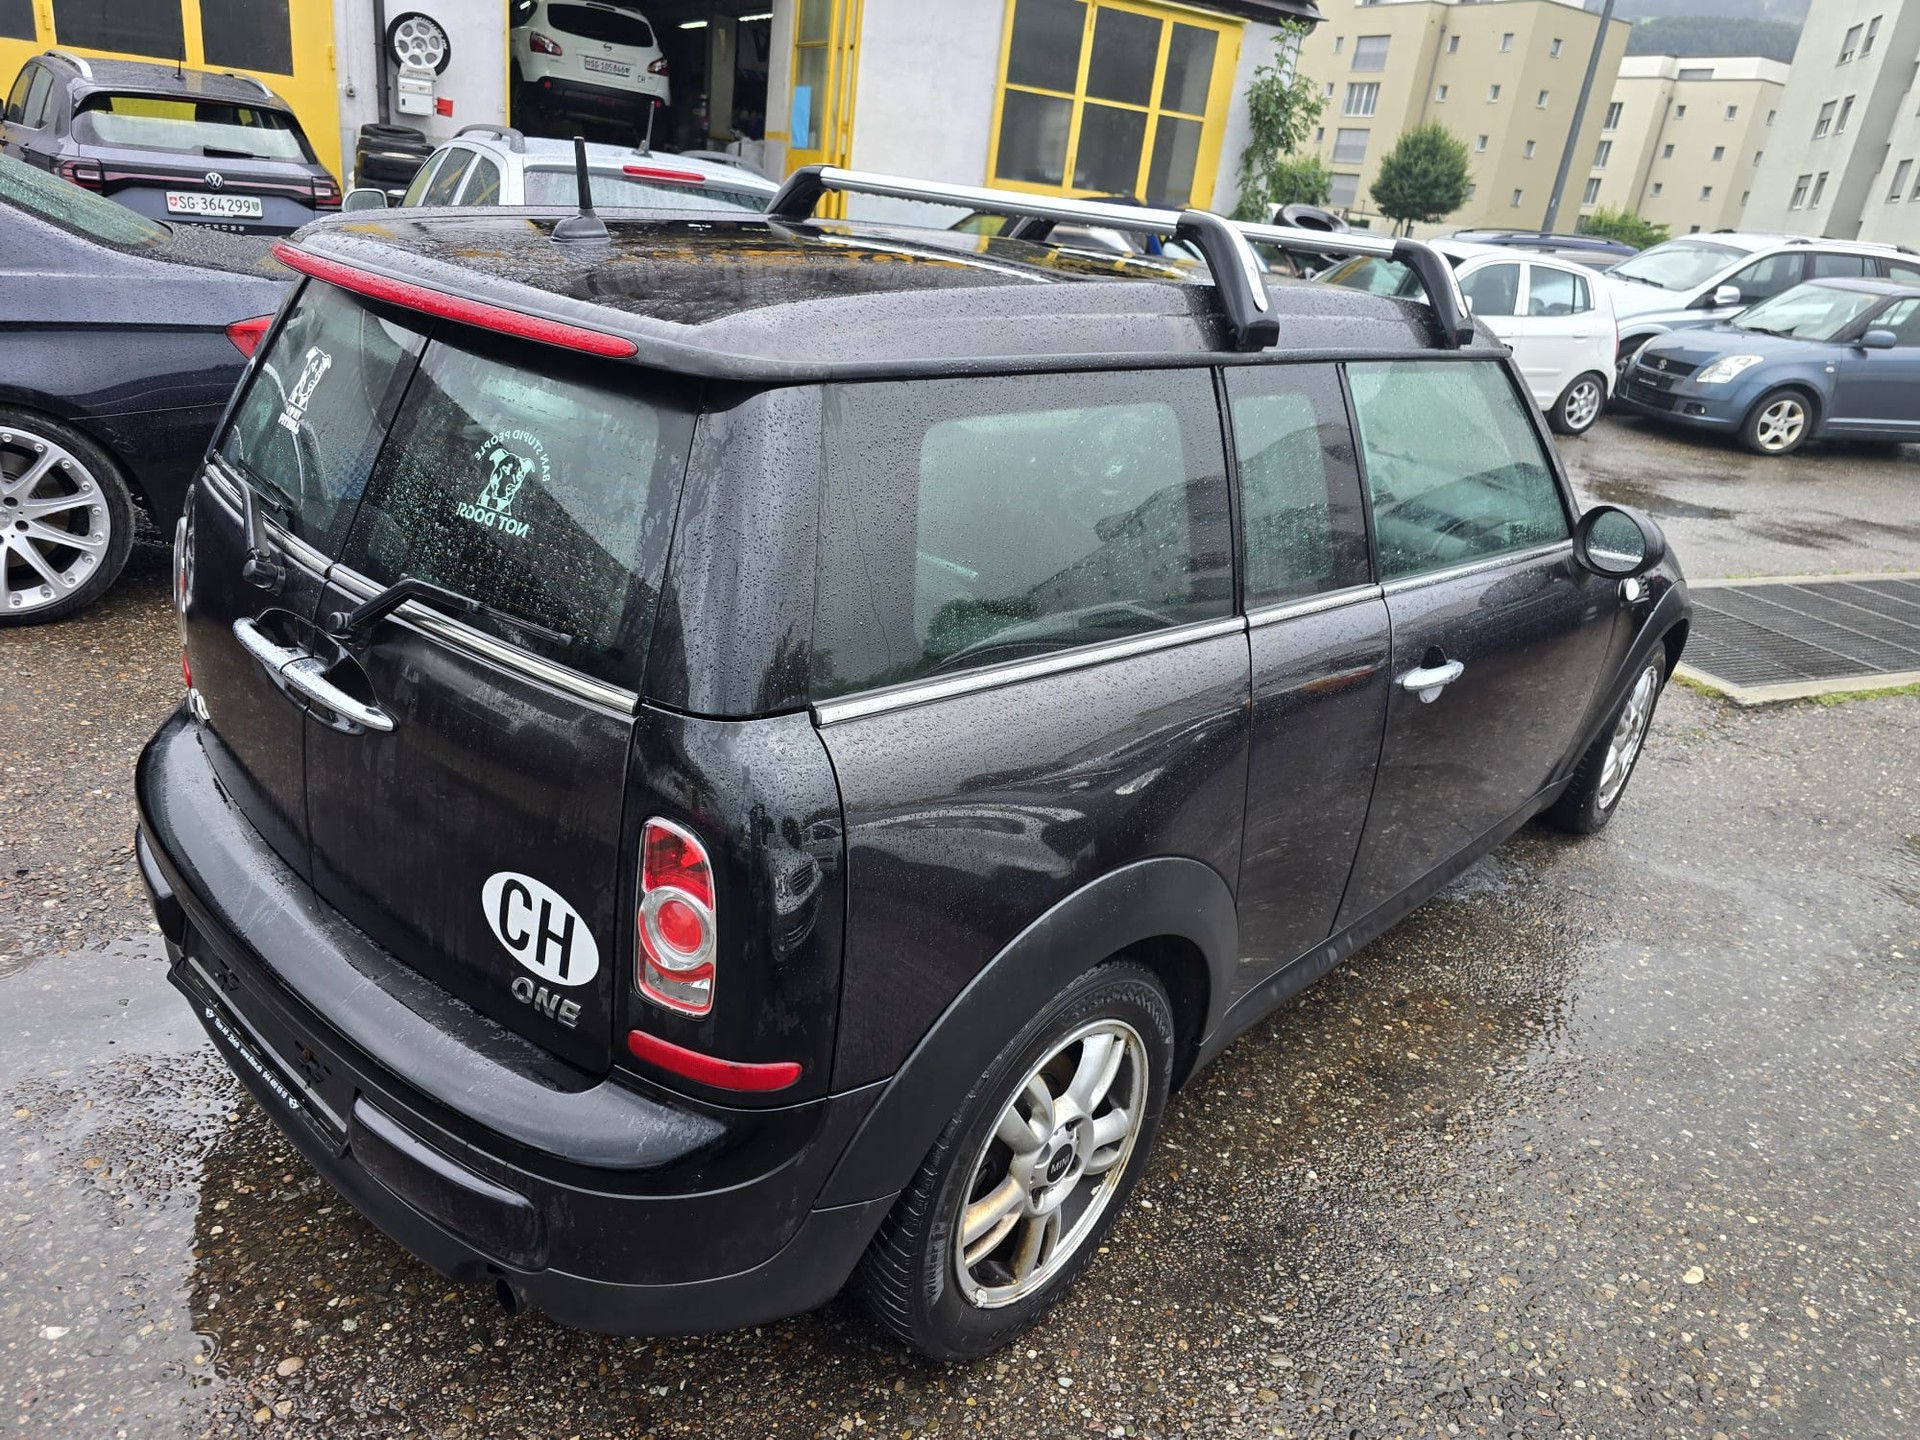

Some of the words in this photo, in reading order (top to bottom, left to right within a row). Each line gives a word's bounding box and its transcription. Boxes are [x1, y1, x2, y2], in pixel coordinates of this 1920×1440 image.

[499, 878, 576, 981] CH
[511, 976, 583, 1030] ONE
[1050, 1153, 1070, 1174] MINI
